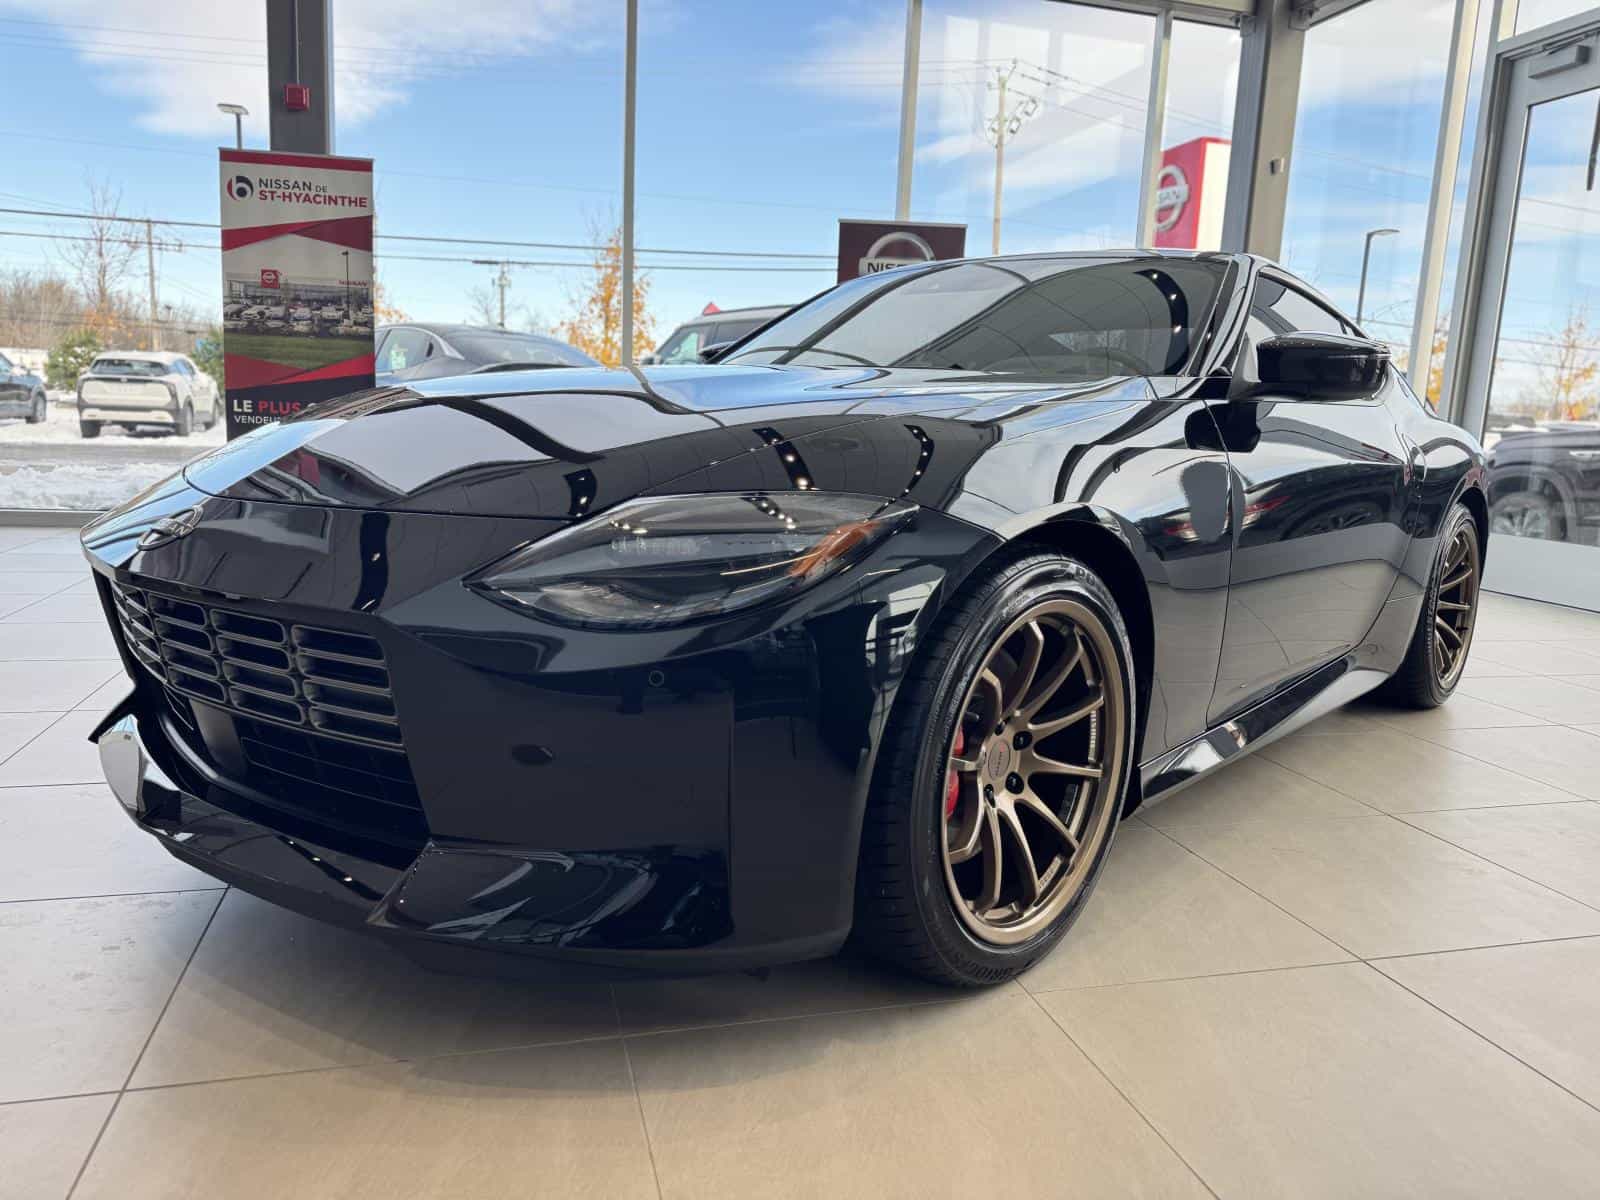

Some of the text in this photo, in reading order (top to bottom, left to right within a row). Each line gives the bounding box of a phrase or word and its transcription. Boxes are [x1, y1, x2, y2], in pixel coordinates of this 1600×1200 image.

[258, 178, 328, 193] NISSAN DE
[258, 189, 368, 208] ST-HYACINTHE
[233, 399, 253, 412] LE
[258, 400, 301, 415] PLUS
[233, 415, 281, 425] VENDEU
